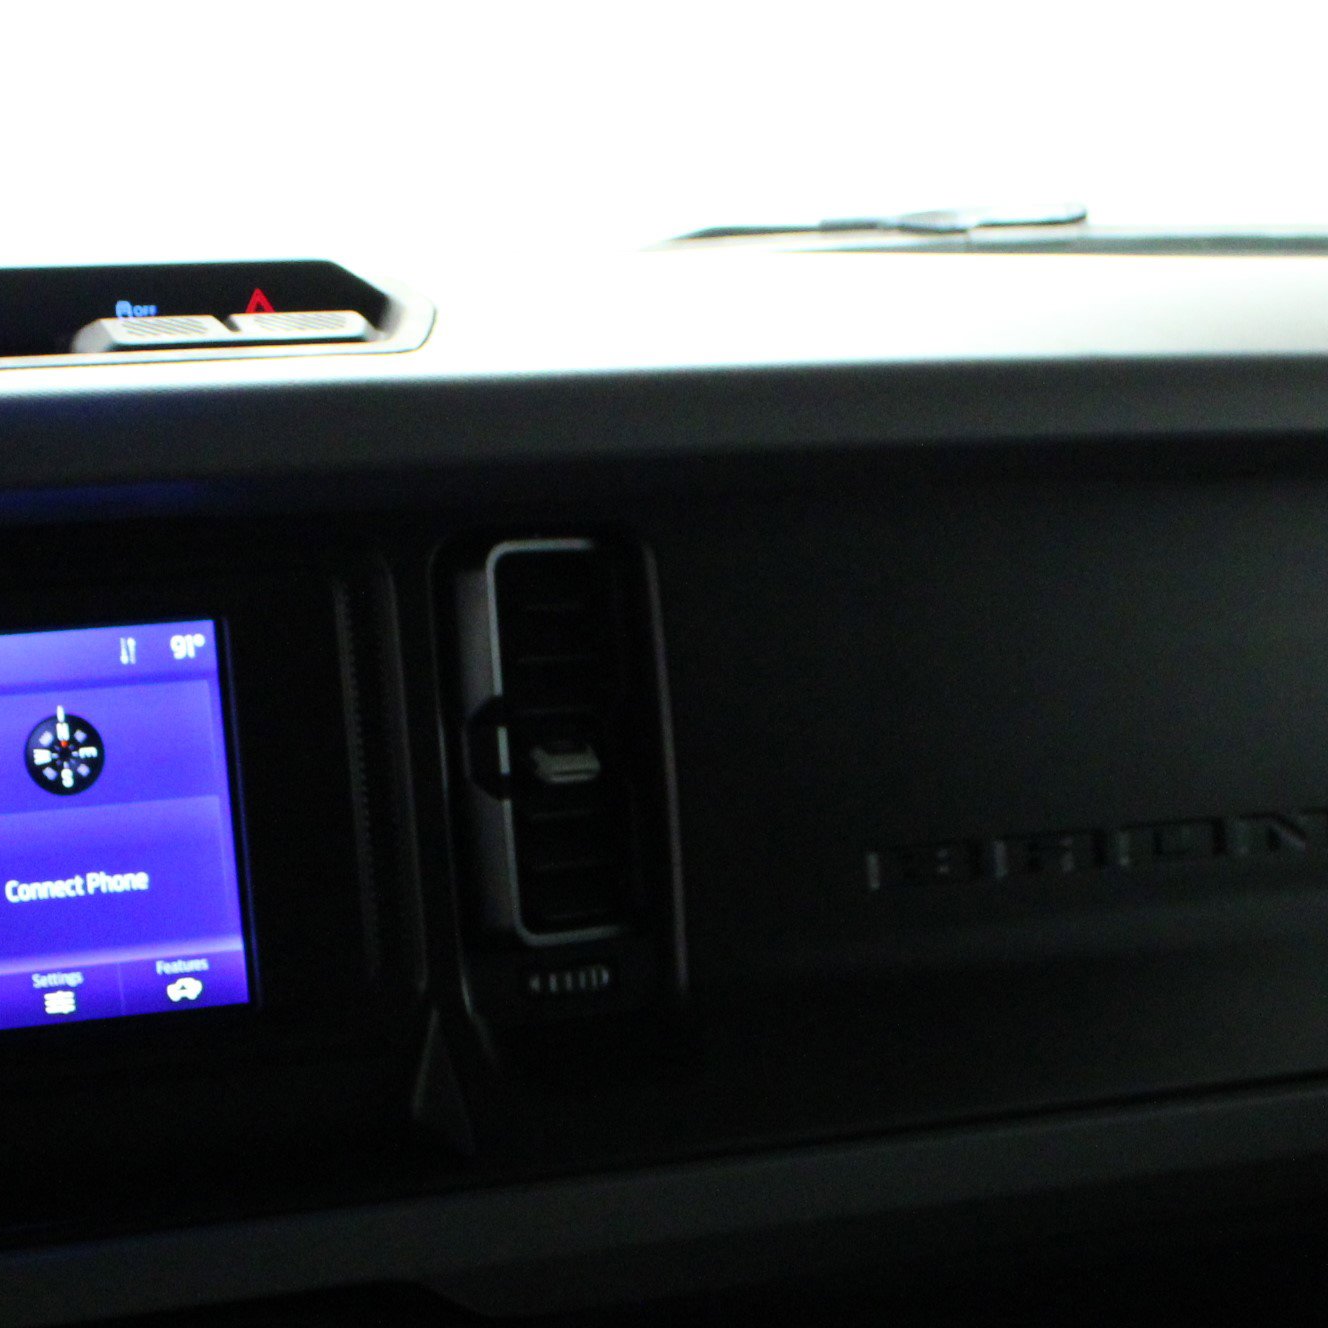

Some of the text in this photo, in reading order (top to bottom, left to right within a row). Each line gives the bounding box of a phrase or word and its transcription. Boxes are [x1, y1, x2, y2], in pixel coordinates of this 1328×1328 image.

[4, 867, 149, 904] Connect Phone
[156, 958, 209, 976] Features
[32, 970, 83, 990] Settings
